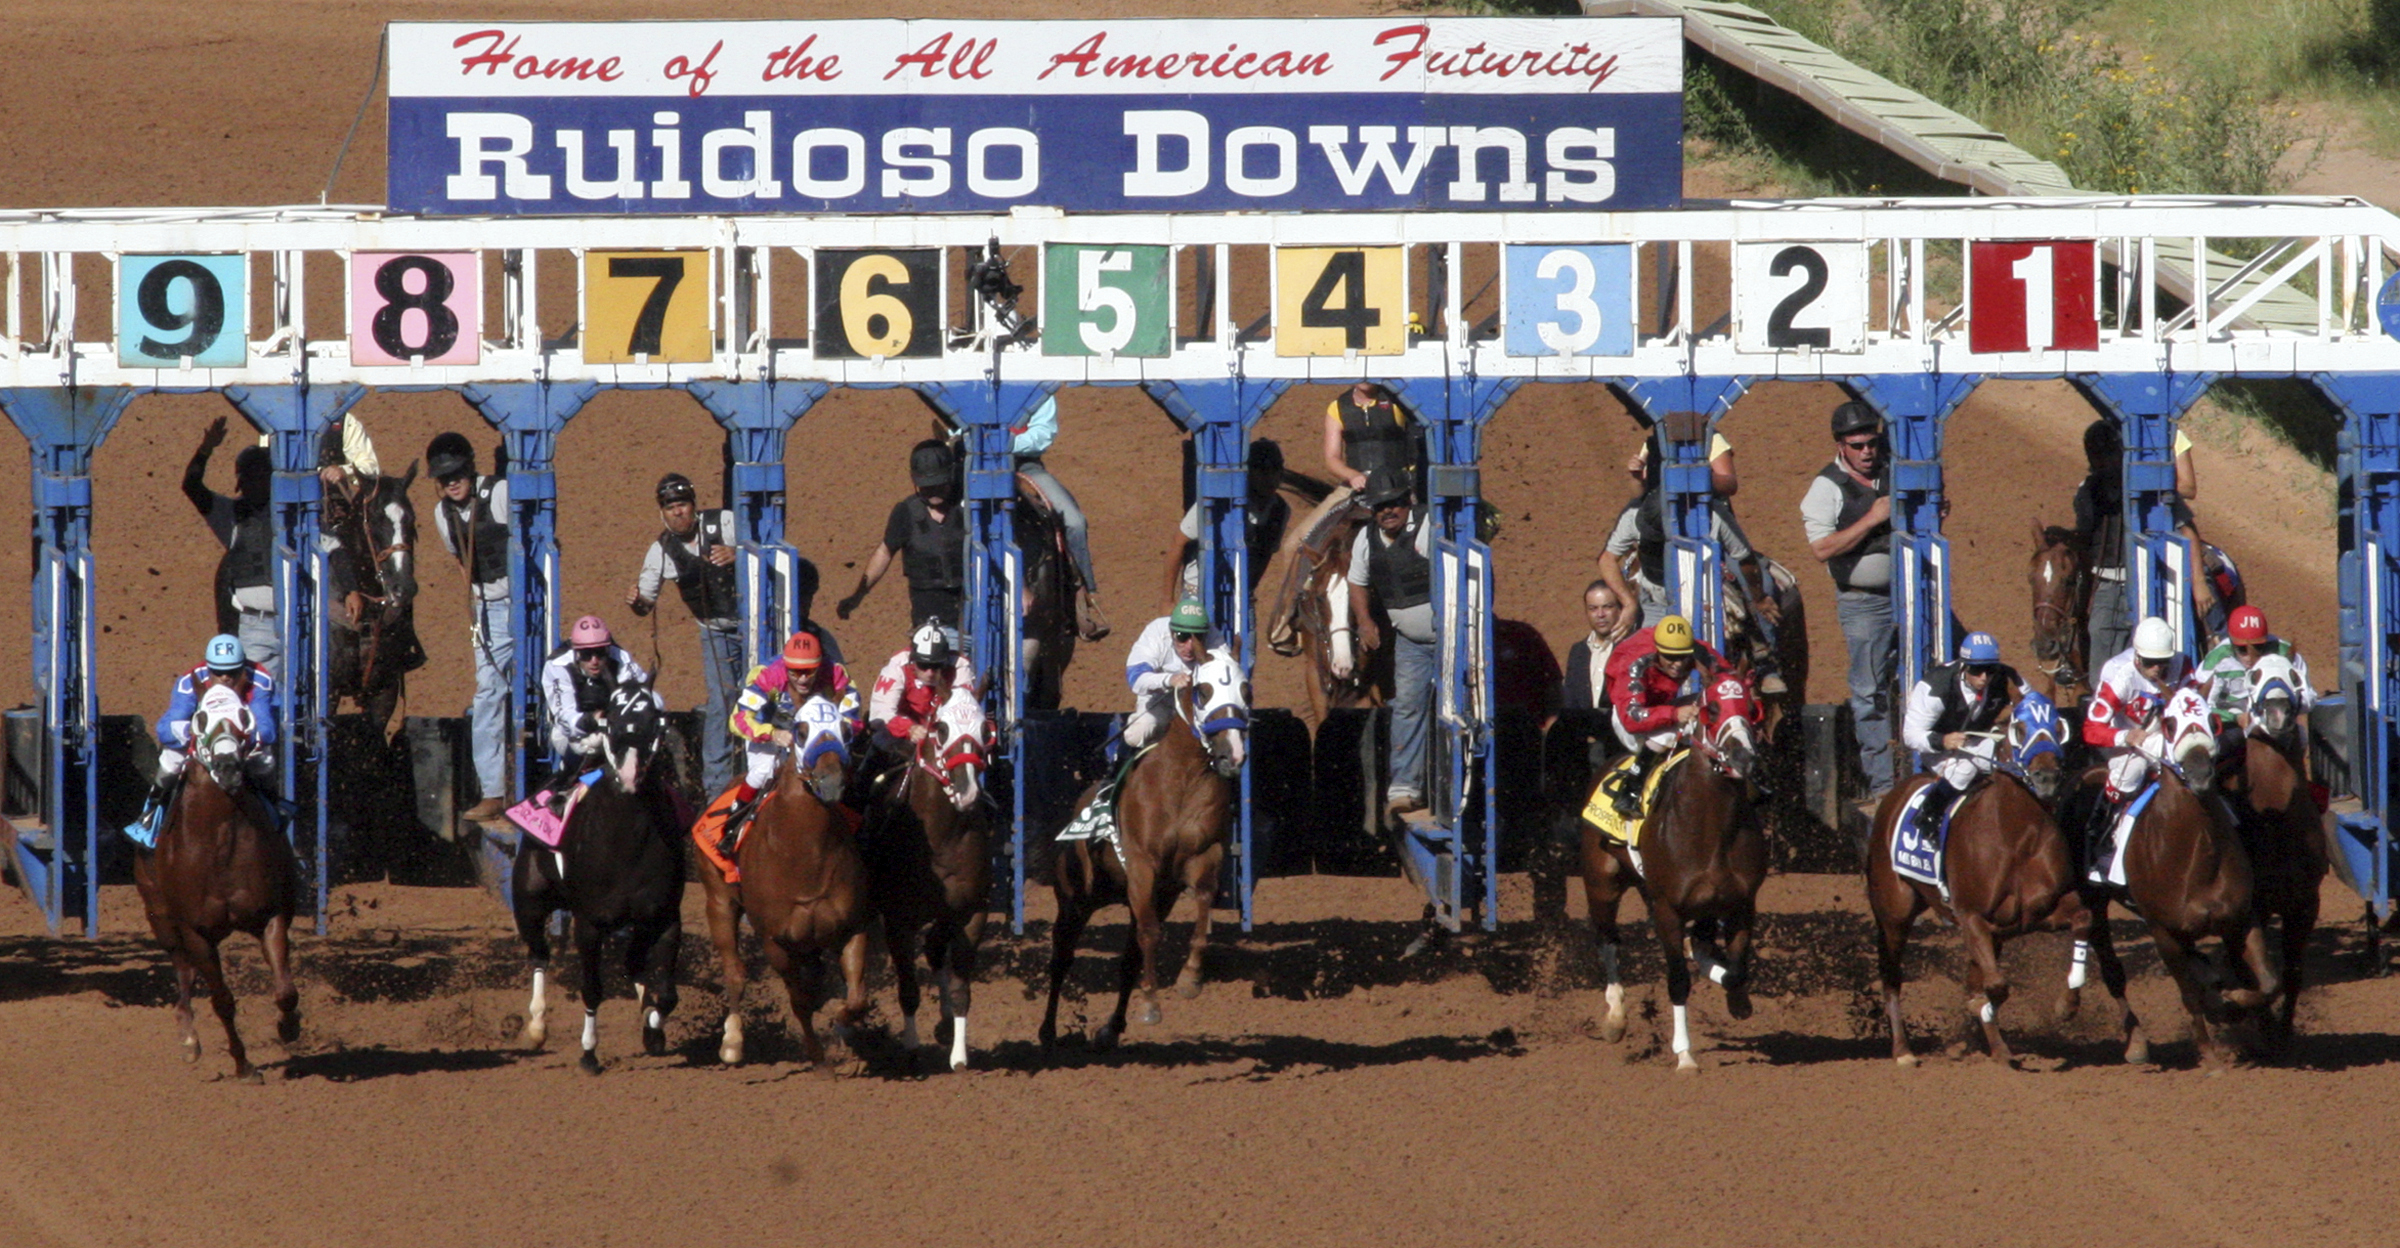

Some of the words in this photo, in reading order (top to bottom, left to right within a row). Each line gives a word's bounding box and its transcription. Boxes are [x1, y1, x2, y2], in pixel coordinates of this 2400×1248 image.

[454, 29, 622, 81] Home
[665, 41, 722, 96] of
[762, 34, 841, 81] the
[884, 31, 997, 79] All
[1039, 31, 1332, 80] American
[1374, 24, 1618, 93] Futurity
[446, 110, 1040, 200] Ruidoso
[1123, 109, 1616, 203] Downs
[137, 259, 226, 360] 9
[371, 255, 459, 361] 8
[608, 257, 685, 356] 7
[839, 253, 912, 358] 6
[1076, 250, 1136, 352] 5
[1301, 251, 1380, 350] 4
[1536, 248, 1602, 351] 3
[1767, 245, 1831, 347] 2
[2012, 246, 2052, 347] 1
[793, 638, 811, 651] RH
[923, 630, 941, 644] JB
[1180, 604, 1203, 616] GRC
[1666, 622, 1686, 635] OR
[1972, 634, 1993, 646] RR
[2239, 616, 2260, 628] JM
[214, 642, 235, 657] ER
[874, 674, 896, 696] W
[1219, 665, 1231, 686] J
[2028, 700, 2051, 724] W
